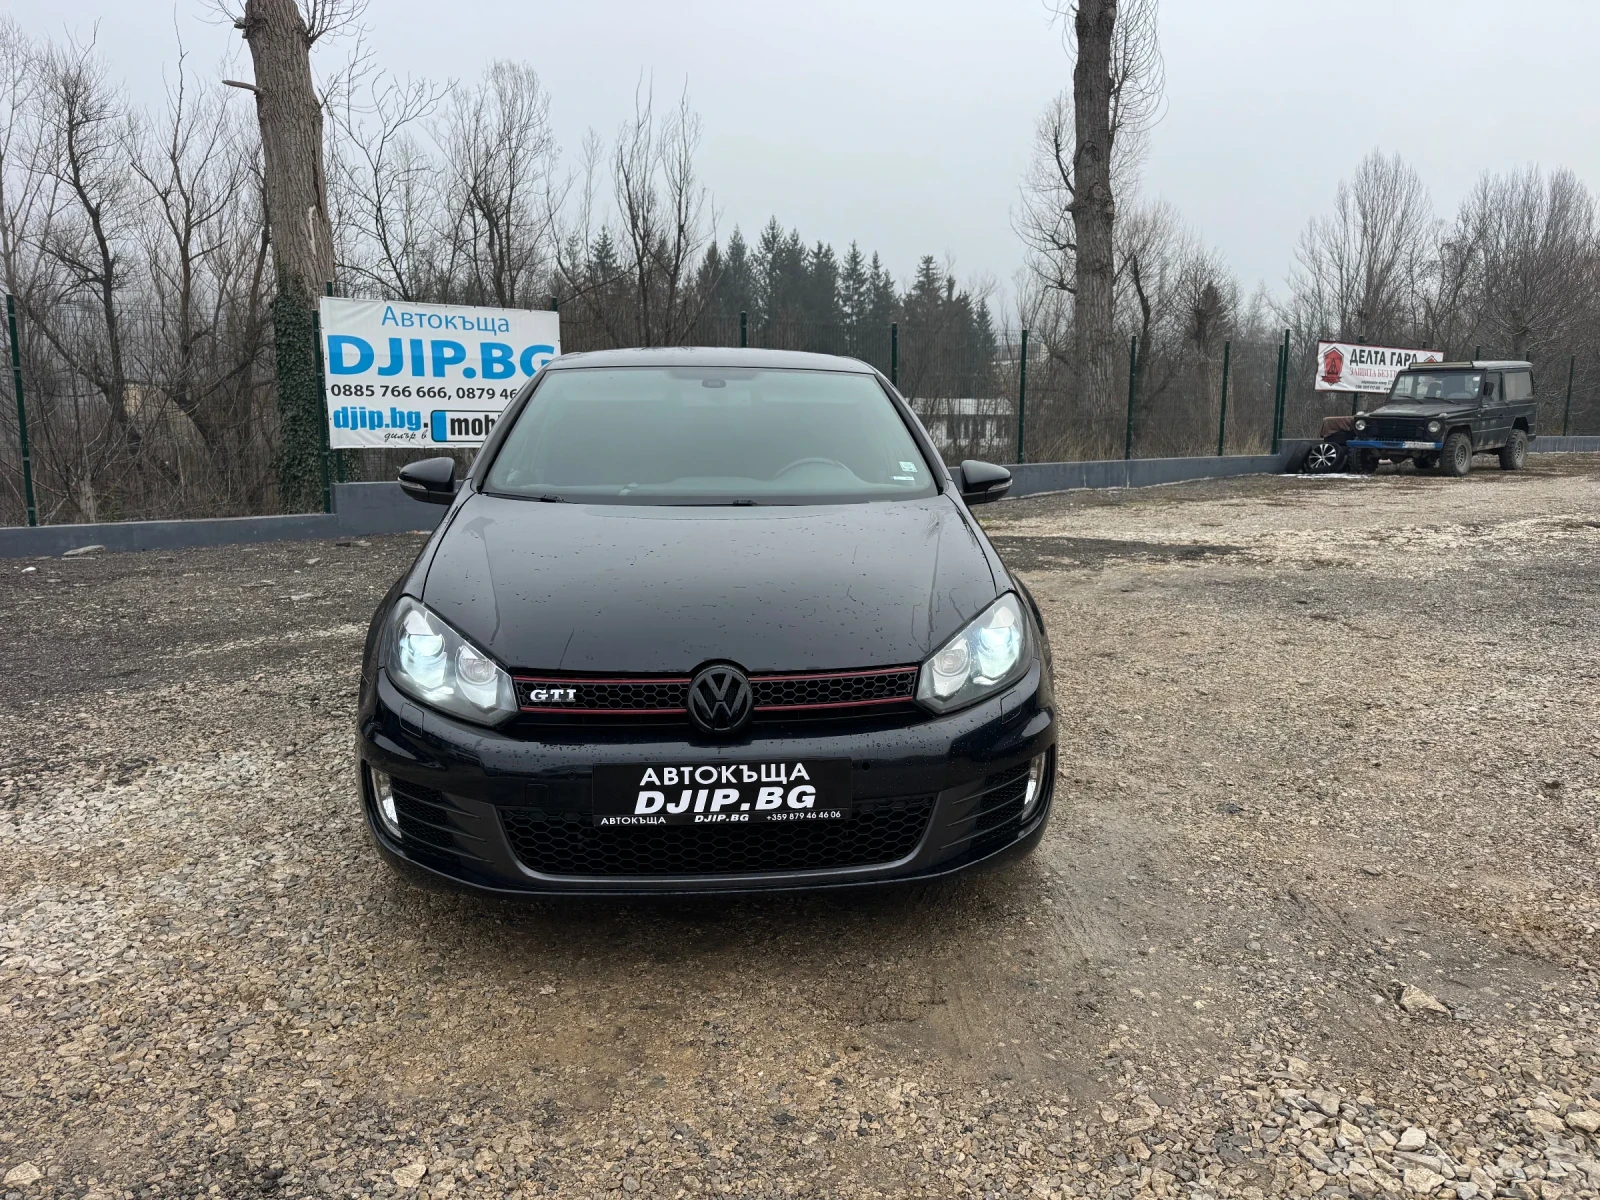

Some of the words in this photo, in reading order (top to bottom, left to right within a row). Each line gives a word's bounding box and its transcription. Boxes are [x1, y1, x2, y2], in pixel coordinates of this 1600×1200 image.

[381, 305, 510, 336] Автокъща
[327, 335, 555, 381] DJIP.BG
[1349, 348, 1386, 367] ДЕЛТА
[330, 384, 375, 398] 0885
[380, 385, 412, 398] 766
[416, 387, 452, 401] 666,
[456, 387, 496, 400] 0879
[529, 688, 577, 703] GTI
[639, 762, 811, 786] АВТОКЪЩА
[634, 784, 817, 815] DJIP.BG
[600, 816, 667, 826] АВТОКЪЩА
[694, 813, 750, 823] DJIP.BG
[766, 813, 787, 821] +359
[789, 812, 805, 820] 879
[806, 811, 817, 820] 46
[818, 811, 829, 819] 46
[830, 810, 841, 819] 06
